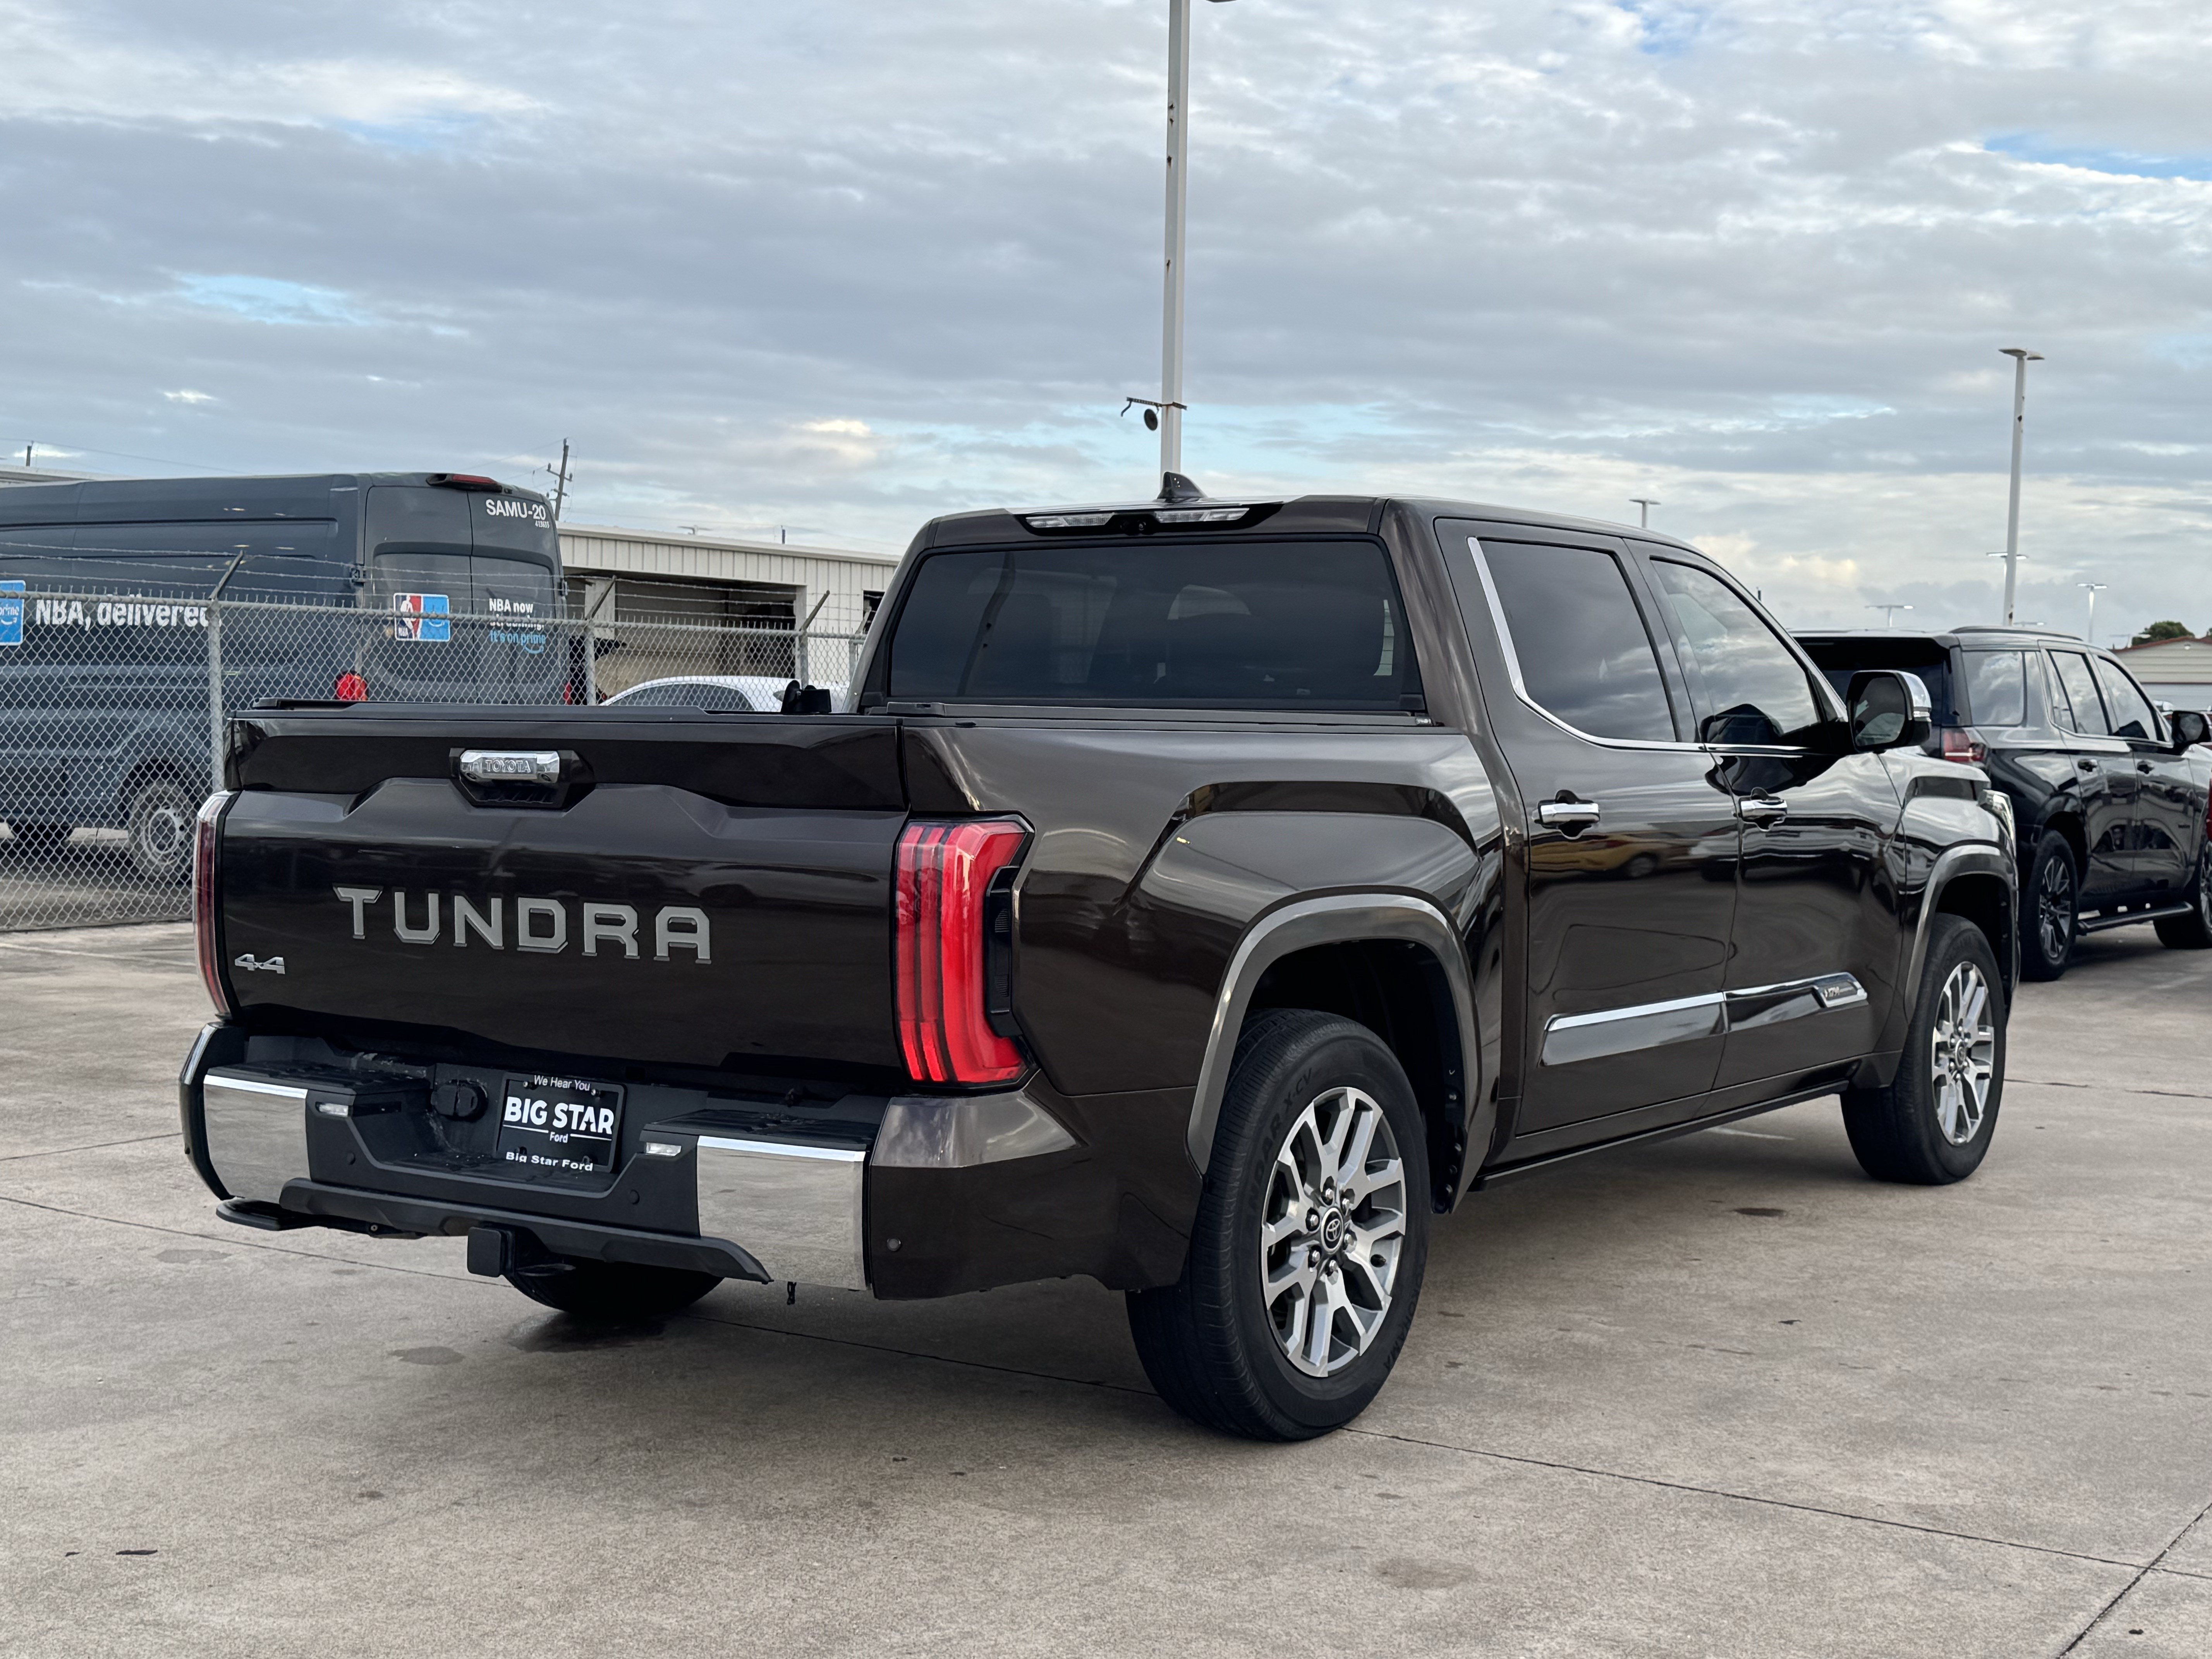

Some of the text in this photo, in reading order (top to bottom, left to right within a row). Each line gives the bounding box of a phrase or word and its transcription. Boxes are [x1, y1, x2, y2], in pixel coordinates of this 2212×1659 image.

[486, 499, 546, 520] SAMU-20
[489, 598, 533, 613] NBA now
[36, 599, 91, 631] NBA,
[507, 633, 518, 643] on
[521, 632, 546, 646] prime
[485, 759, 531, 773] TOYOTA
[332, 886, 712, 964] TUNDRA
[534, 1075, 590, 1091] We Hear You
[504, 1096, 614, 1135] BIG STAR
[549, 1131, 568, 1143] Ford
[506, 1151, 593, 1171] Big Star Ford
